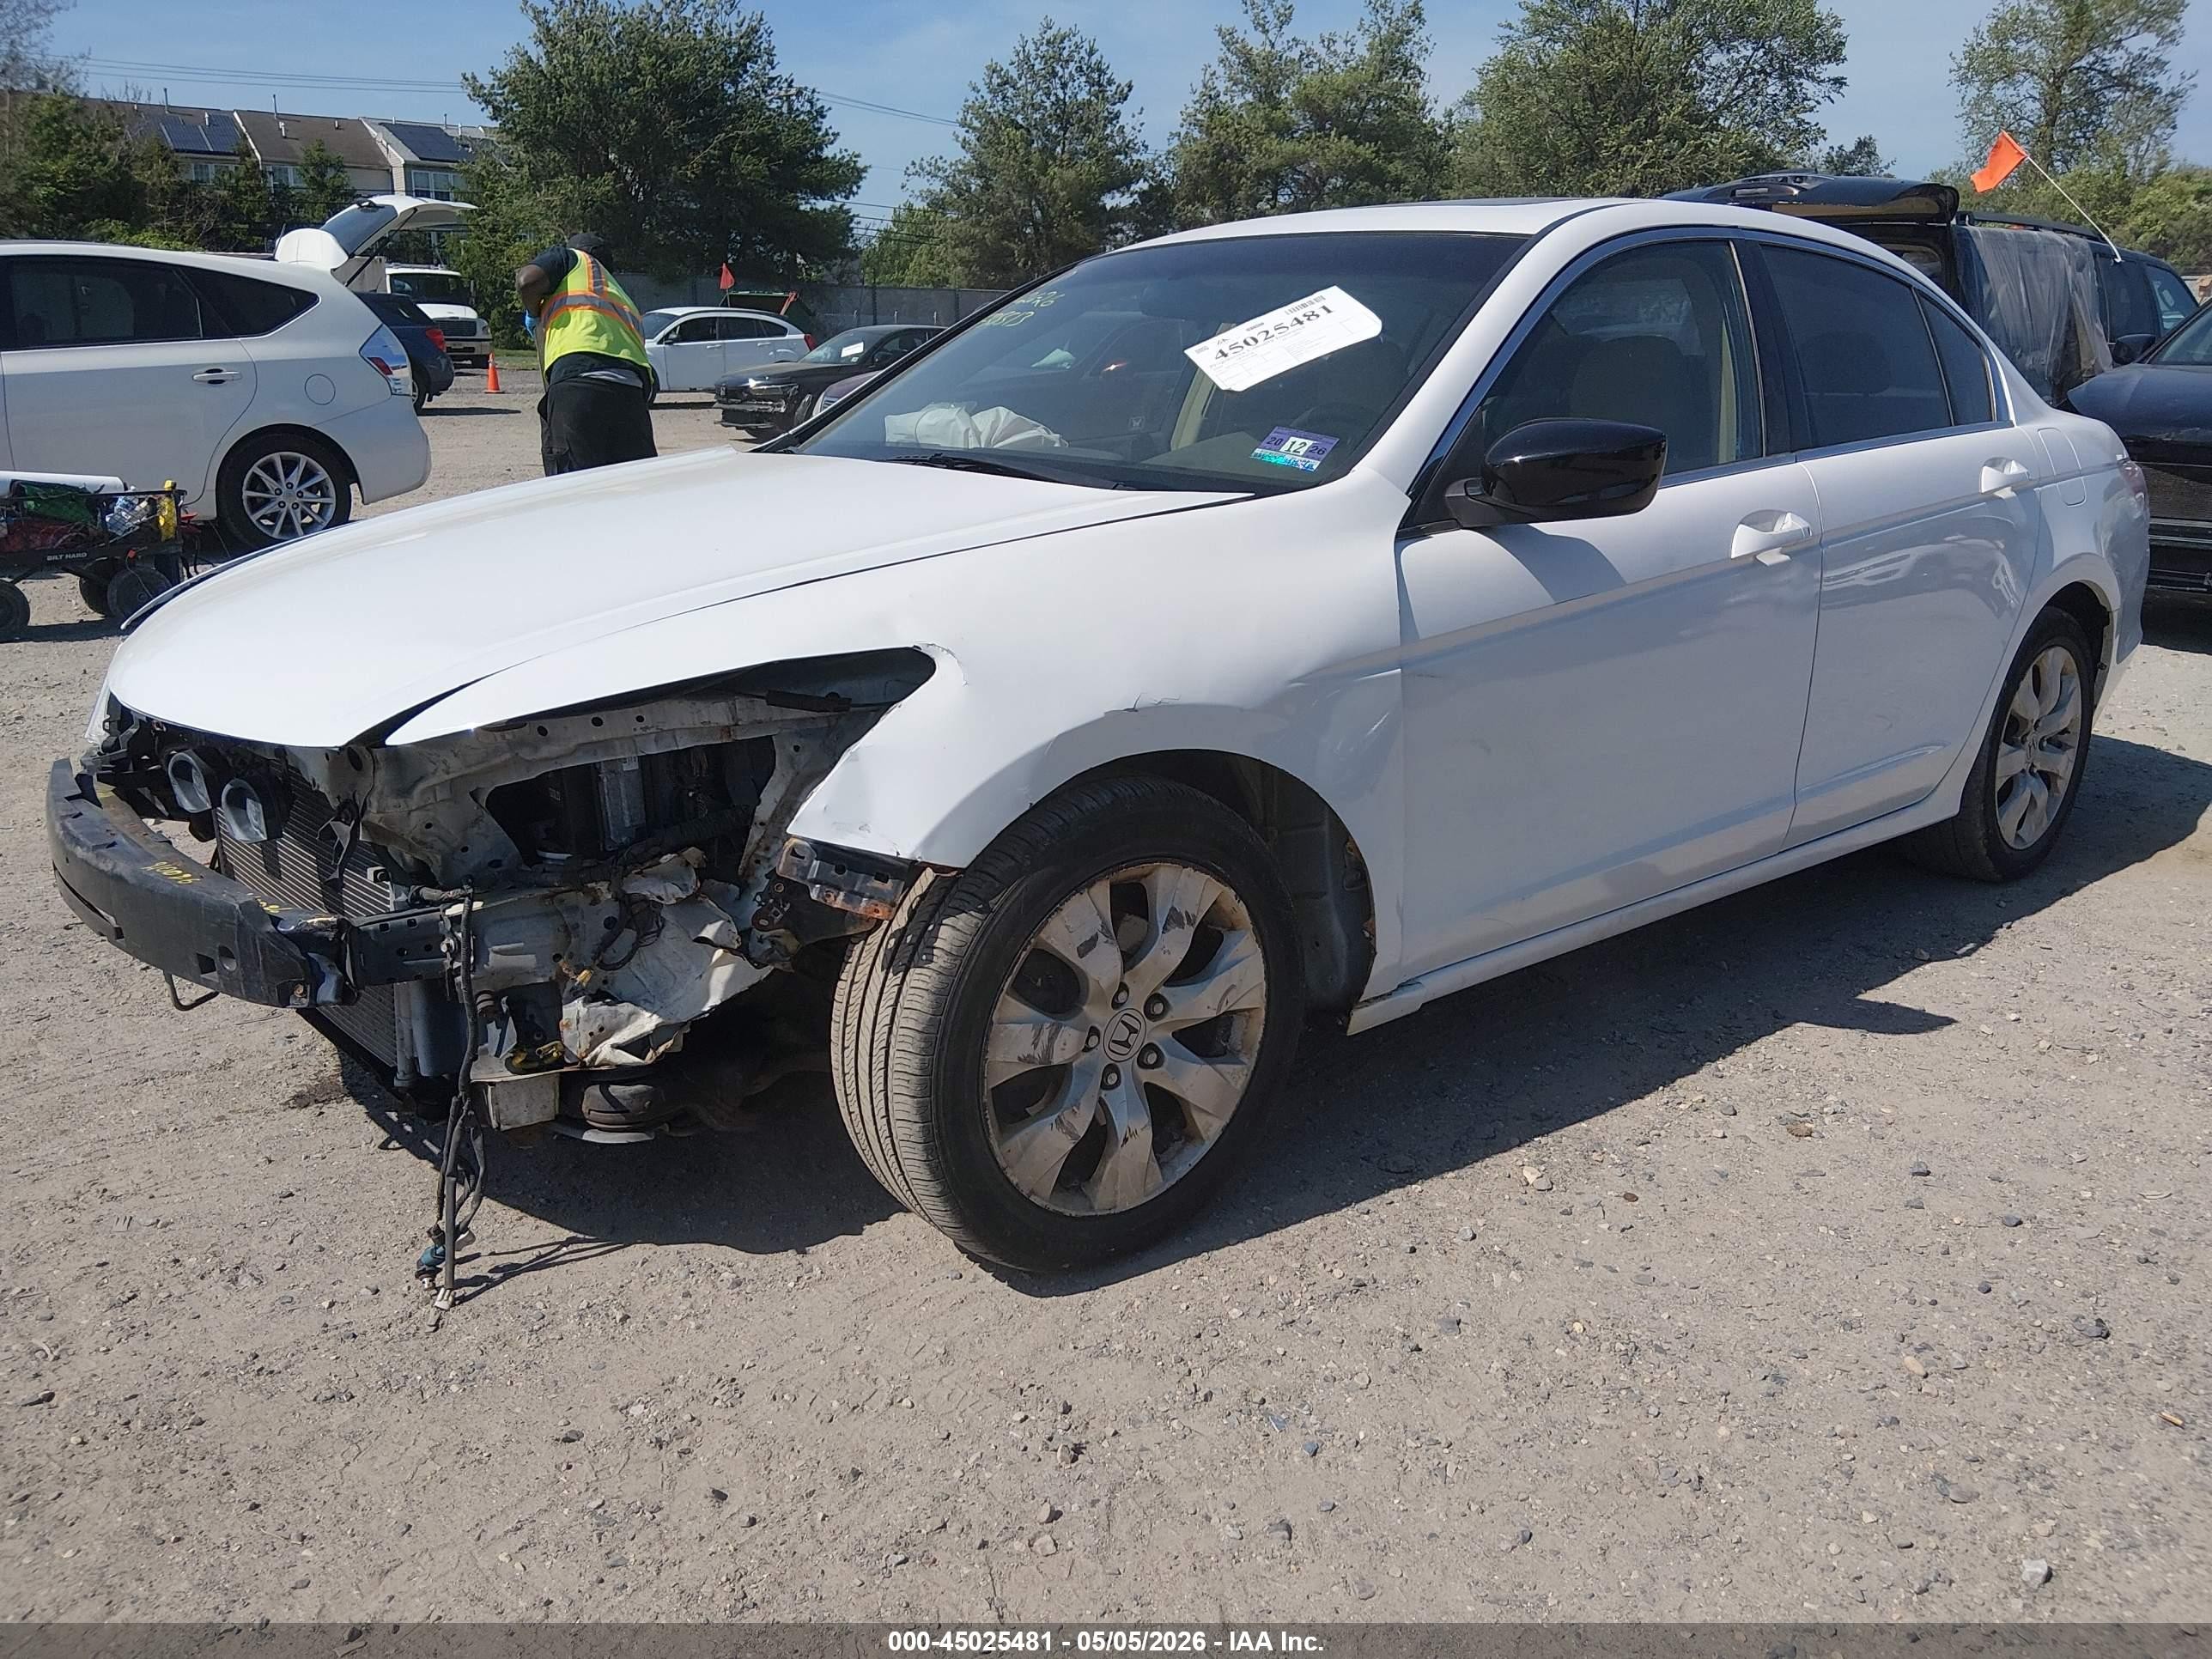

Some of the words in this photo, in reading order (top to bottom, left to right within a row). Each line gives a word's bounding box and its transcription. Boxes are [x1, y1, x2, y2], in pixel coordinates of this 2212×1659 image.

[1213, 304, 1334, 361] 45025481
[1266, 436, 1284, 447] 20
[1284, 440, 1308, 454] 12
[1309, 445, 1328, 455] 26
